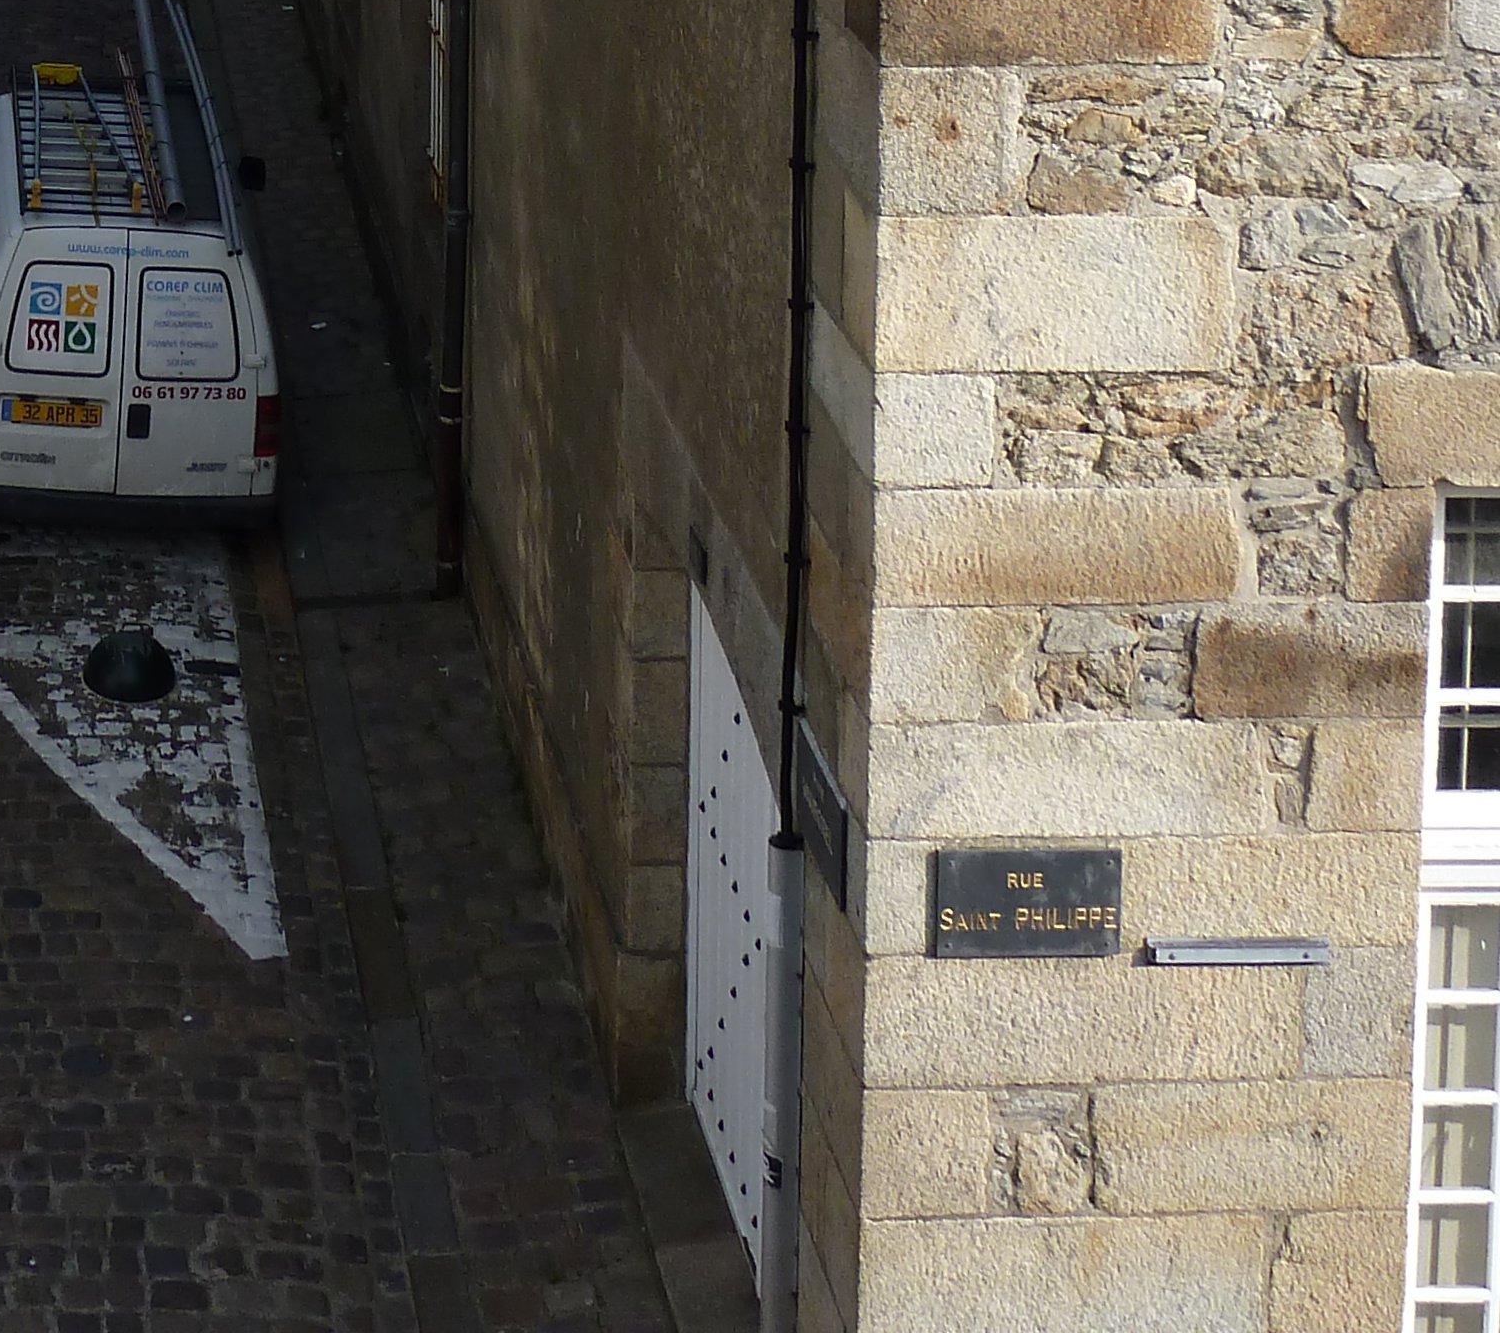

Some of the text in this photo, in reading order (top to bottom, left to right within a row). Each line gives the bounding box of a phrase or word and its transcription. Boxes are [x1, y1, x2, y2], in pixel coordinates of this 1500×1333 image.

[146, 280, 224, 294] COREP CLIM
[132, 386, 247, 400] 06 61 97 73 80
[22, 404, 99, 424] 32 APR 35
[1006, 872, 1044, 889] RUE
[1014, 906, 1119, 931] PHILIPPE
